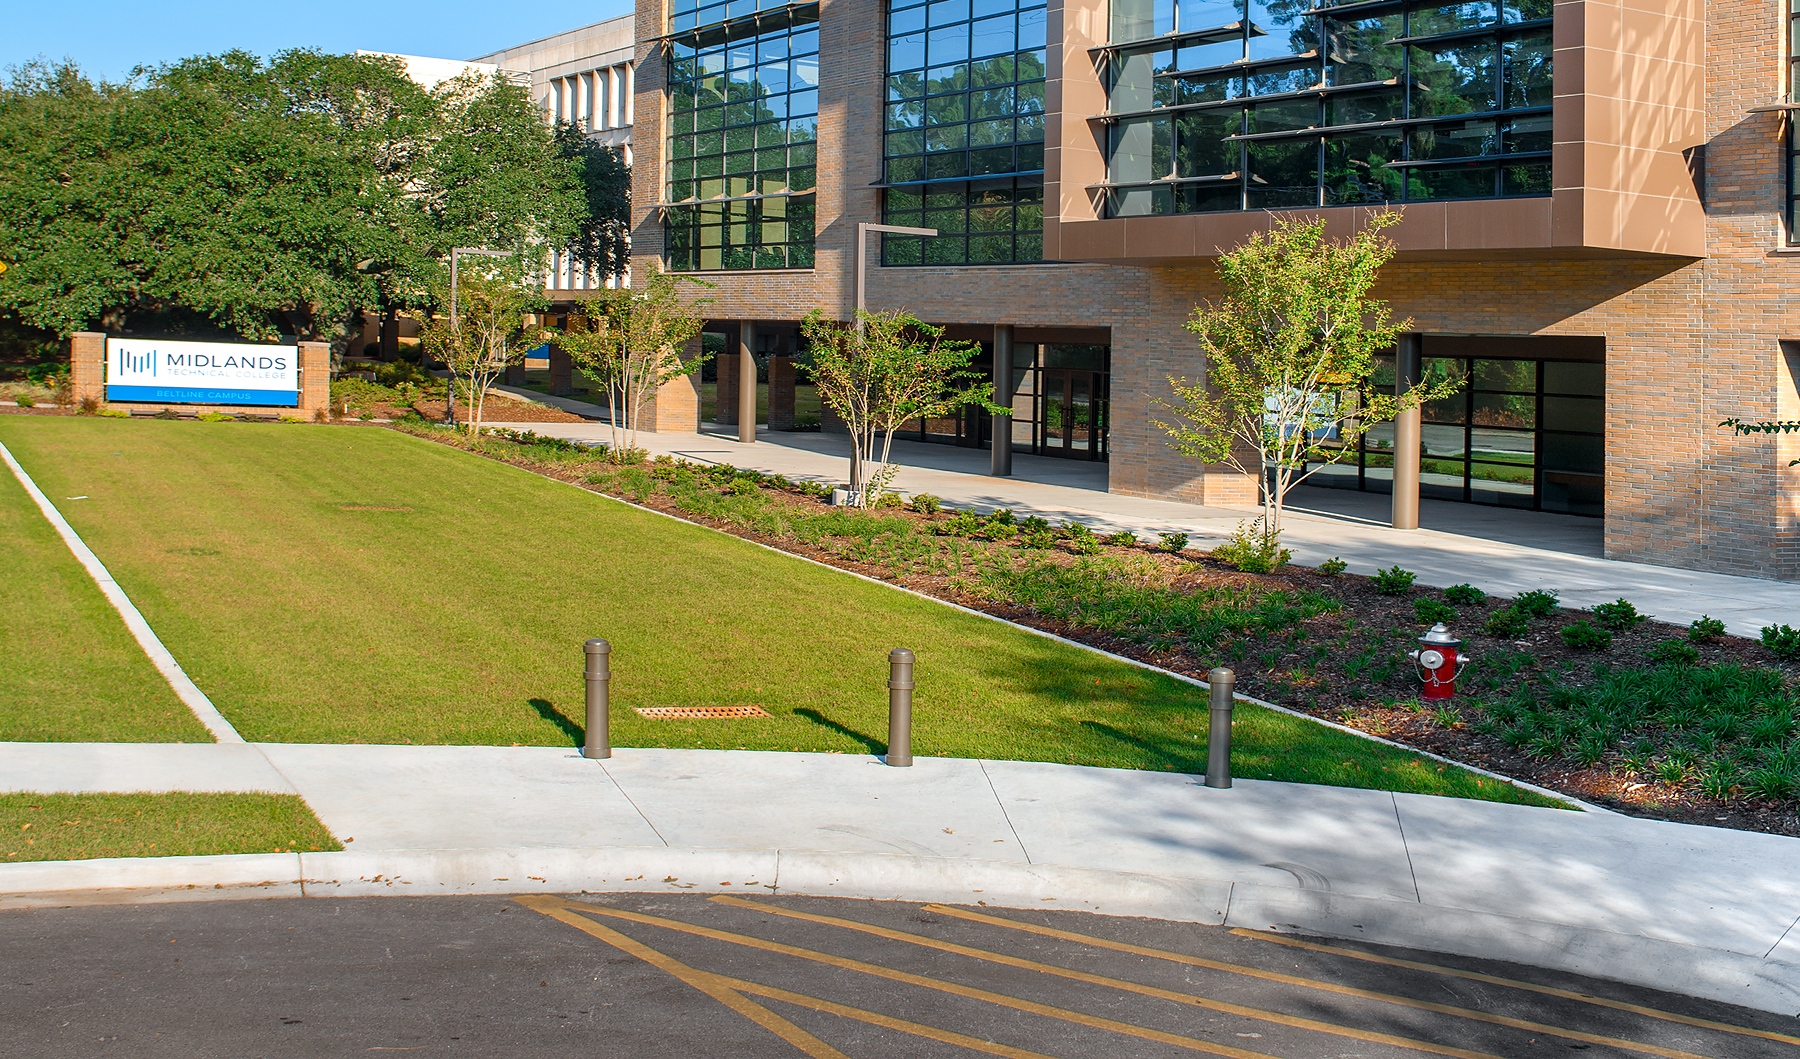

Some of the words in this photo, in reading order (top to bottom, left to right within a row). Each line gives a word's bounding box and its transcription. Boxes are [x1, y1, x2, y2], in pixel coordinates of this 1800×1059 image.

[167, 353, 287, 370] MIDLANDS
[167, 368, 230, 378] TECHNICAL
[235, 370, 286, 380] COLLEGE
[156, 390, 204, 399] BELTLINE
[207, 391, 251, 400] CAMPUS
